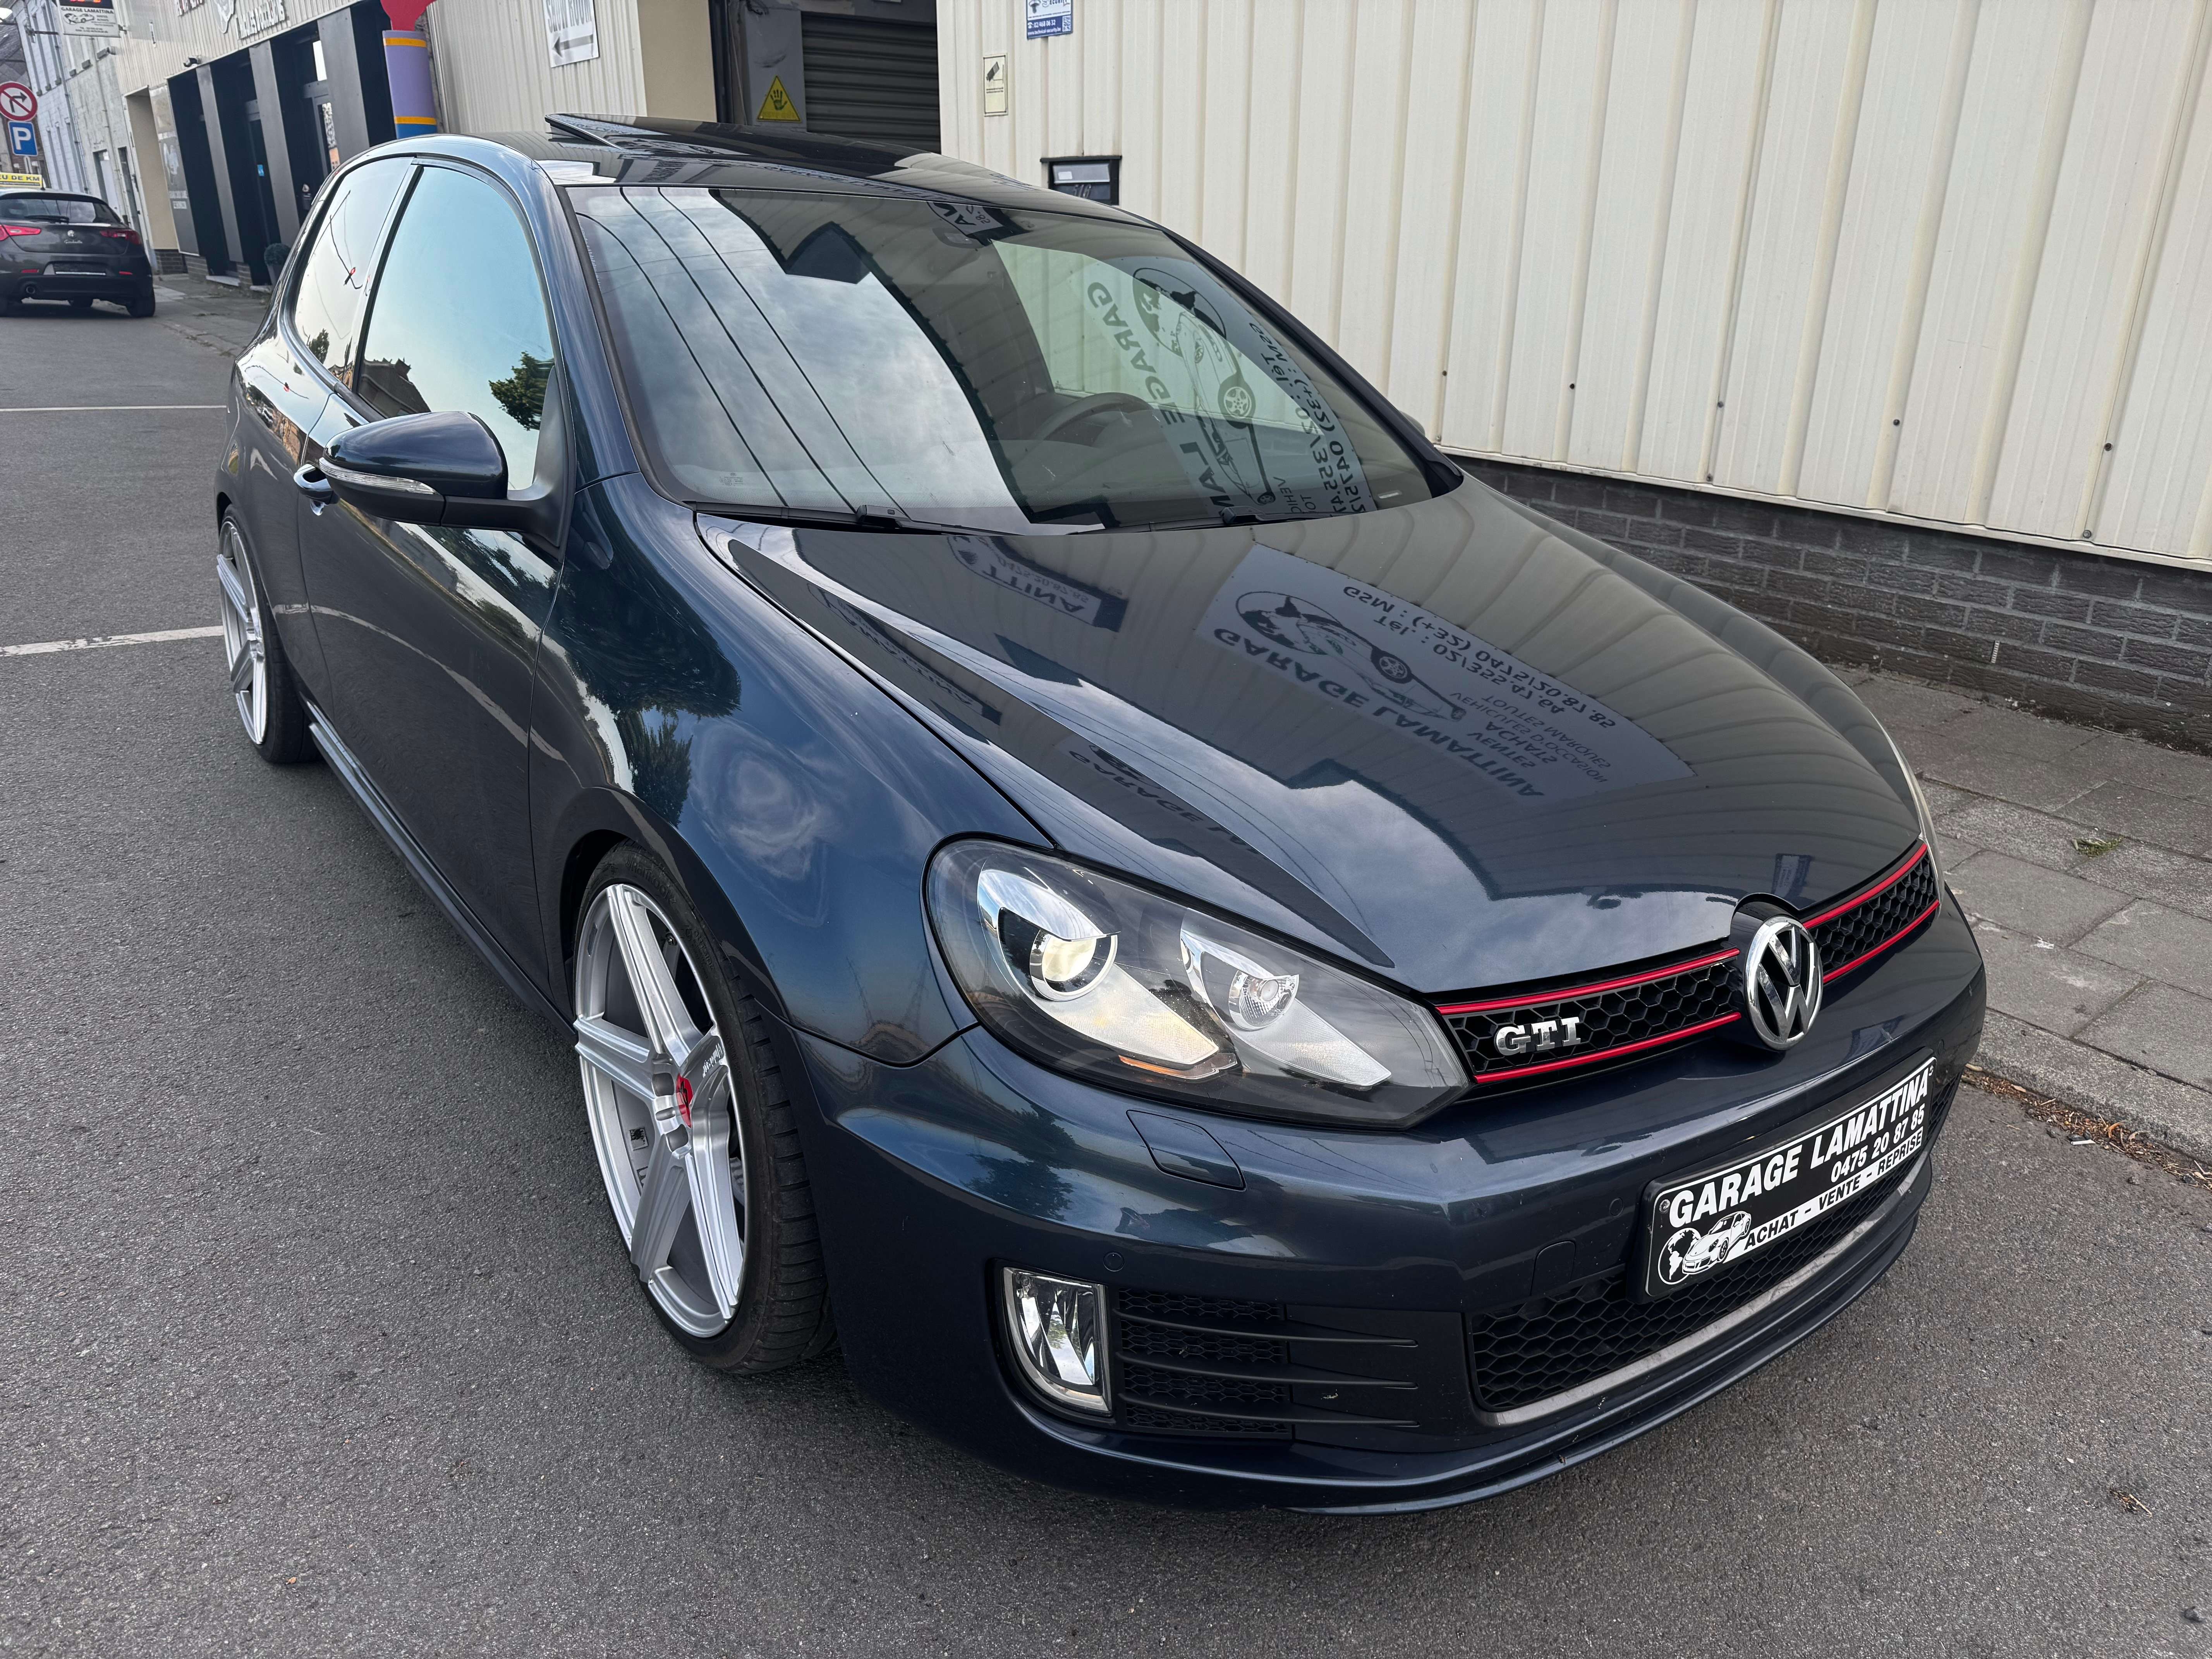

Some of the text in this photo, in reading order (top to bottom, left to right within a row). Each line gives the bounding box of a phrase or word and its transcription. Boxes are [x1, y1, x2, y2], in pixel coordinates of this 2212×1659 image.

[12, 127, 31, 150] P
[1495, 1016, 1581, 1056] GTI
[1669, 1068, 1929, 1228] GARAGE LAMATTINA
[1831, 1104, 1925, 1183] 0475 20 87 85
[1744, 1213, 1798, 1251] ACHAT
[1819, 1176, 1860, 1209] VENTE
[1877, 1128, 1923, 1174] REPRISE
